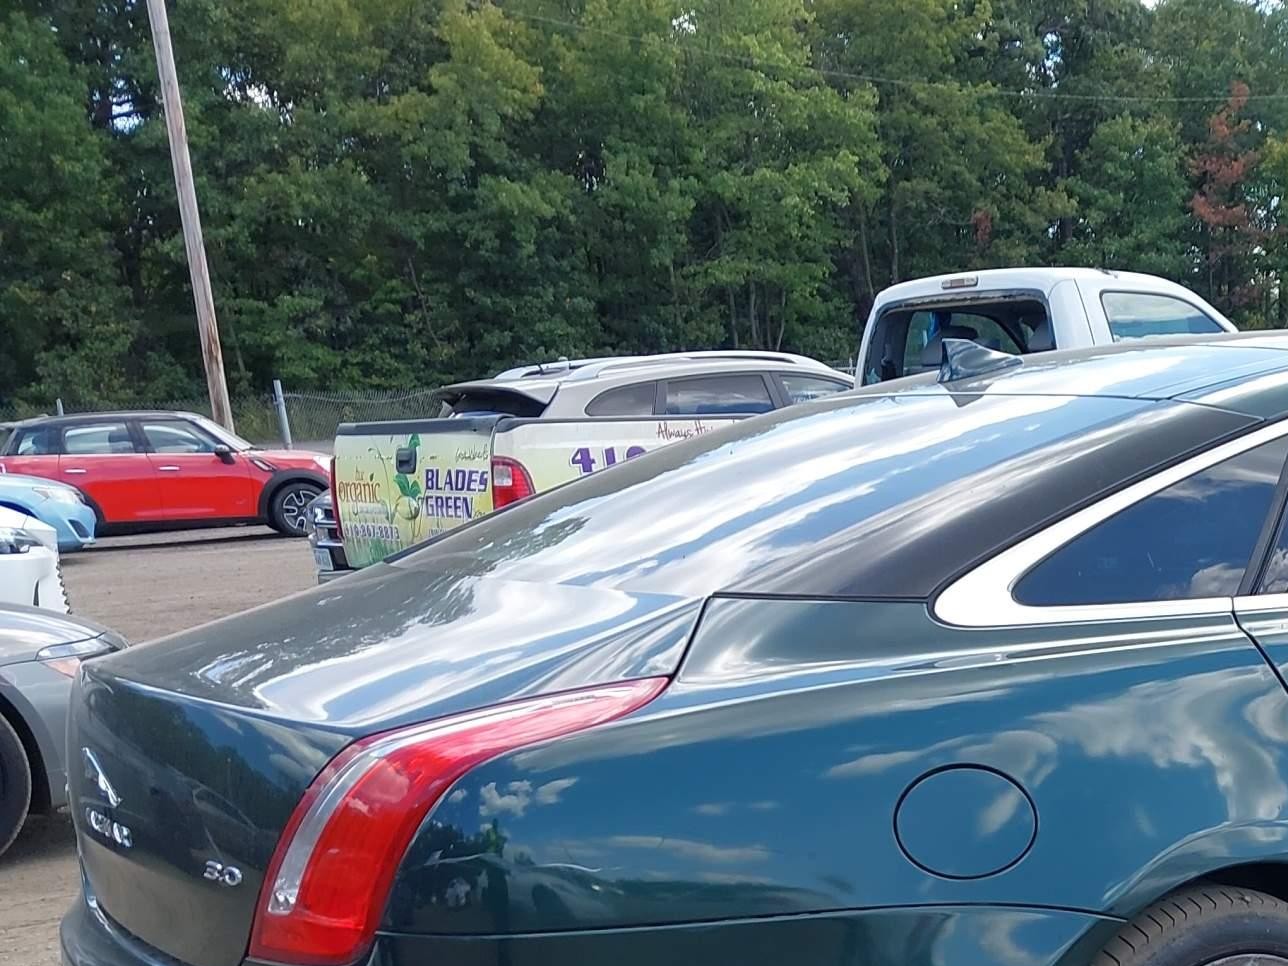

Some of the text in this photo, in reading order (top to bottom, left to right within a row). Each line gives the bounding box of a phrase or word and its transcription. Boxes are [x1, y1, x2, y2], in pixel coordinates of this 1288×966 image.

[656, 421, 694, 440] Always
[425, 468, 489, 492] BLADES
[338, 473, 381, 516] organic
[426, 495, 473, 519] GREEN
[203, 860, 243, 886] 3.0
